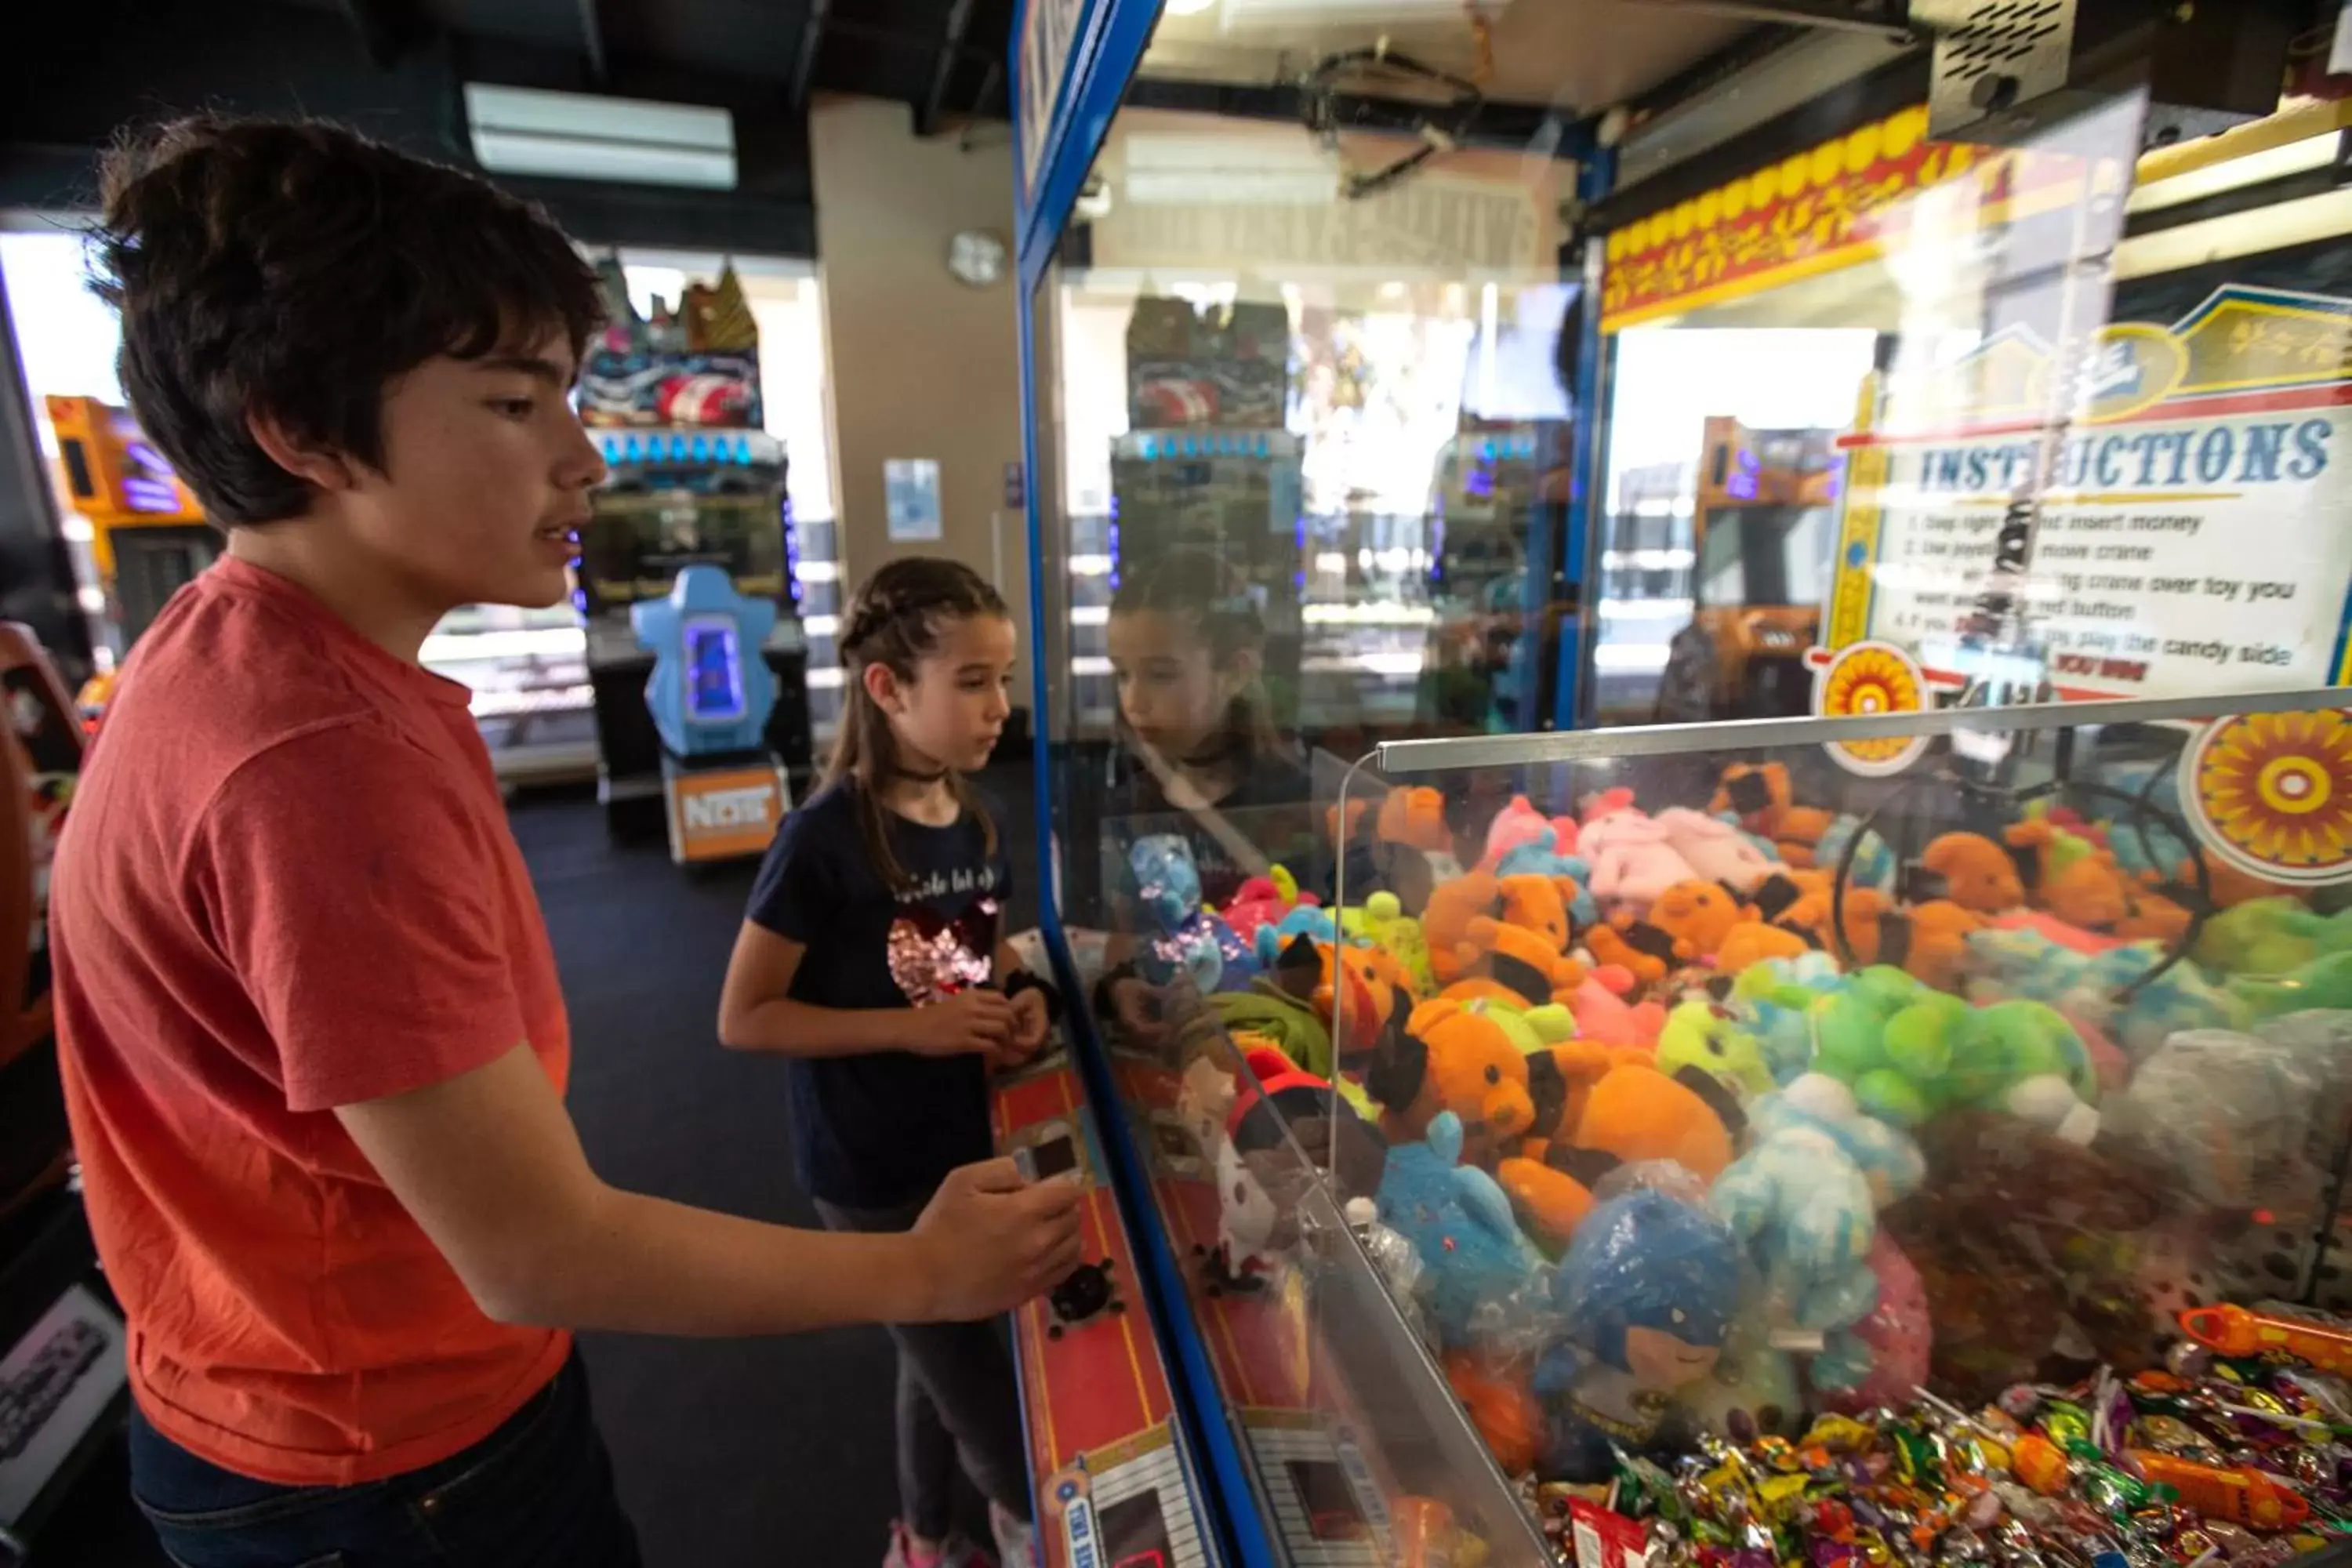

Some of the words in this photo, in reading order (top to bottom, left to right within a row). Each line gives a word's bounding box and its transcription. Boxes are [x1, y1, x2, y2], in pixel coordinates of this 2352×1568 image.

[2069, 514, 2123, 531] insert
[2129, 514, 2204, 535] money
[2042, 546, 2089, 559] move
[2096, 545, 2154, 561] crane
[2088, 574, 2143, 592] crane
[2150, 577, 2198, 593] over
[2203, 575, 2241, 602] toy
[2245, 581, 2298, 603] you
[2071, 600, 2136, 619] button
[2123, 633, 2158, 653] the
[2163, 639, 2234, 665] candy
[2238, 642, 2295, 666] side
[951, 866, 975, 894] lot
